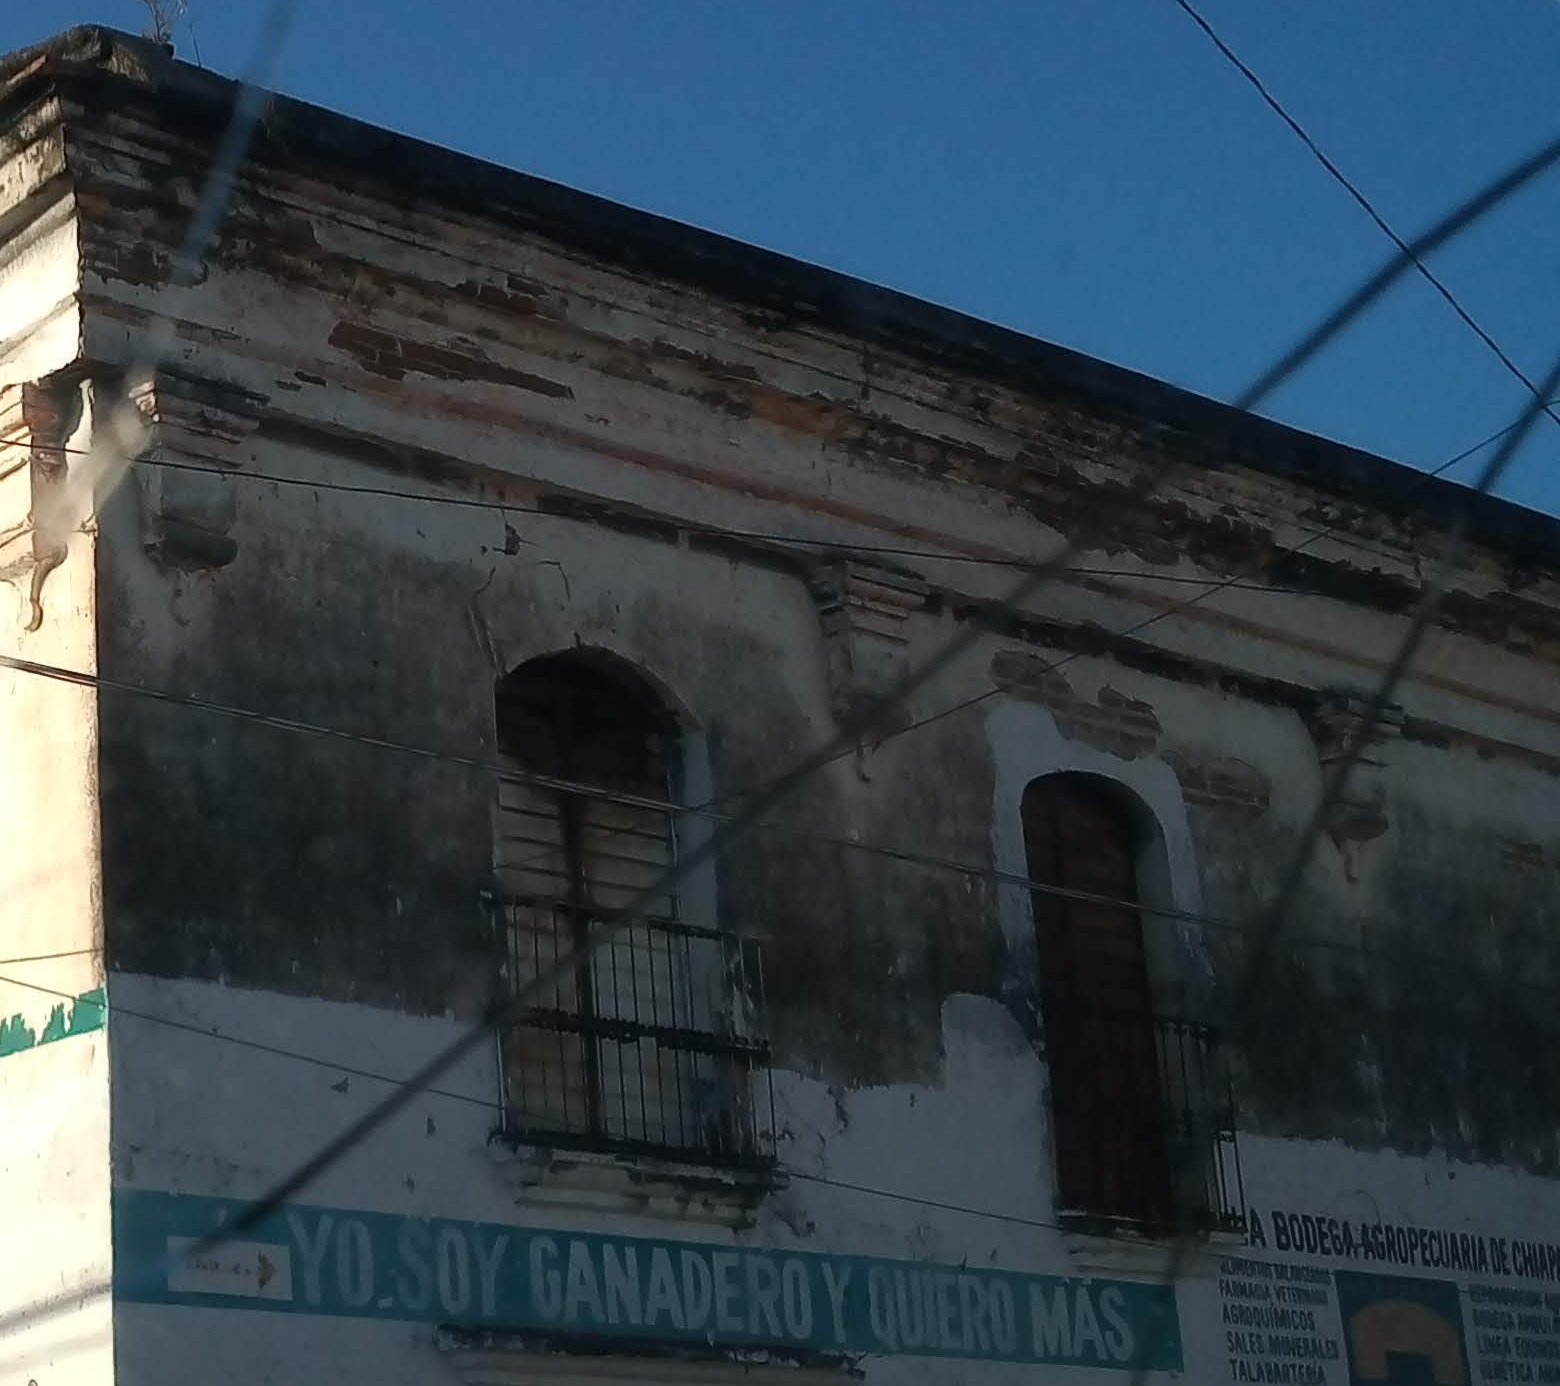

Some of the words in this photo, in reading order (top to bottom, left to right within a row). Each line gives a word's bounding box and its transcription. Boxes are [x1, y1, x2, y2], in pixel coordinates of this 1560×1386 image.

[1272, 1210, 1353, 1256] BODEGA
[1358, 1222, 1488, 1272] AGROPECUARIA
[1490, 1237, 1511, 1276] DE
[529, 1234, 813, 1343] GANADERO
[821, 1259, 853, 1346] Y
[867, 1265, 1016, 1353] QUIERO
